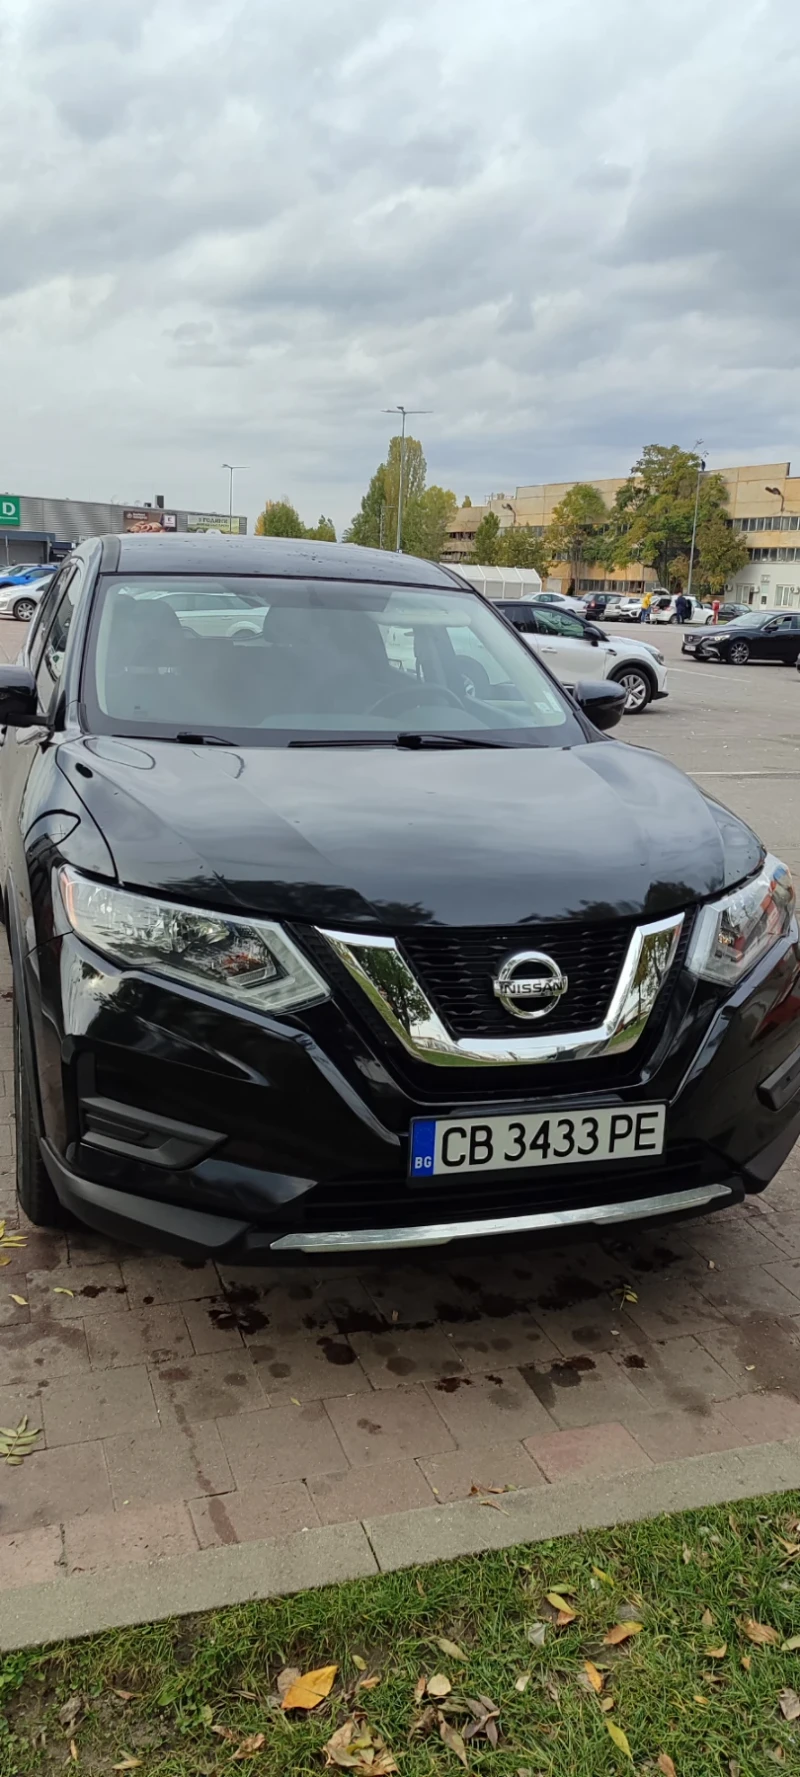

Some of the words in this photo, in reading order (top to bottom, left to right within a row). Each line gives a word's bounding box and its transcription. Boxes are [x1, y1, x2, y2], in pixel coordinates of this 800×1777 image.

[504, 982, 563, 994] NISSAN
[441, 1125, 494, 1167] CB
[503, 1116, 599, 1162] 3433
[608, 1111, 659, 1153] PE
[414, 1156, 432, 1169] BG
